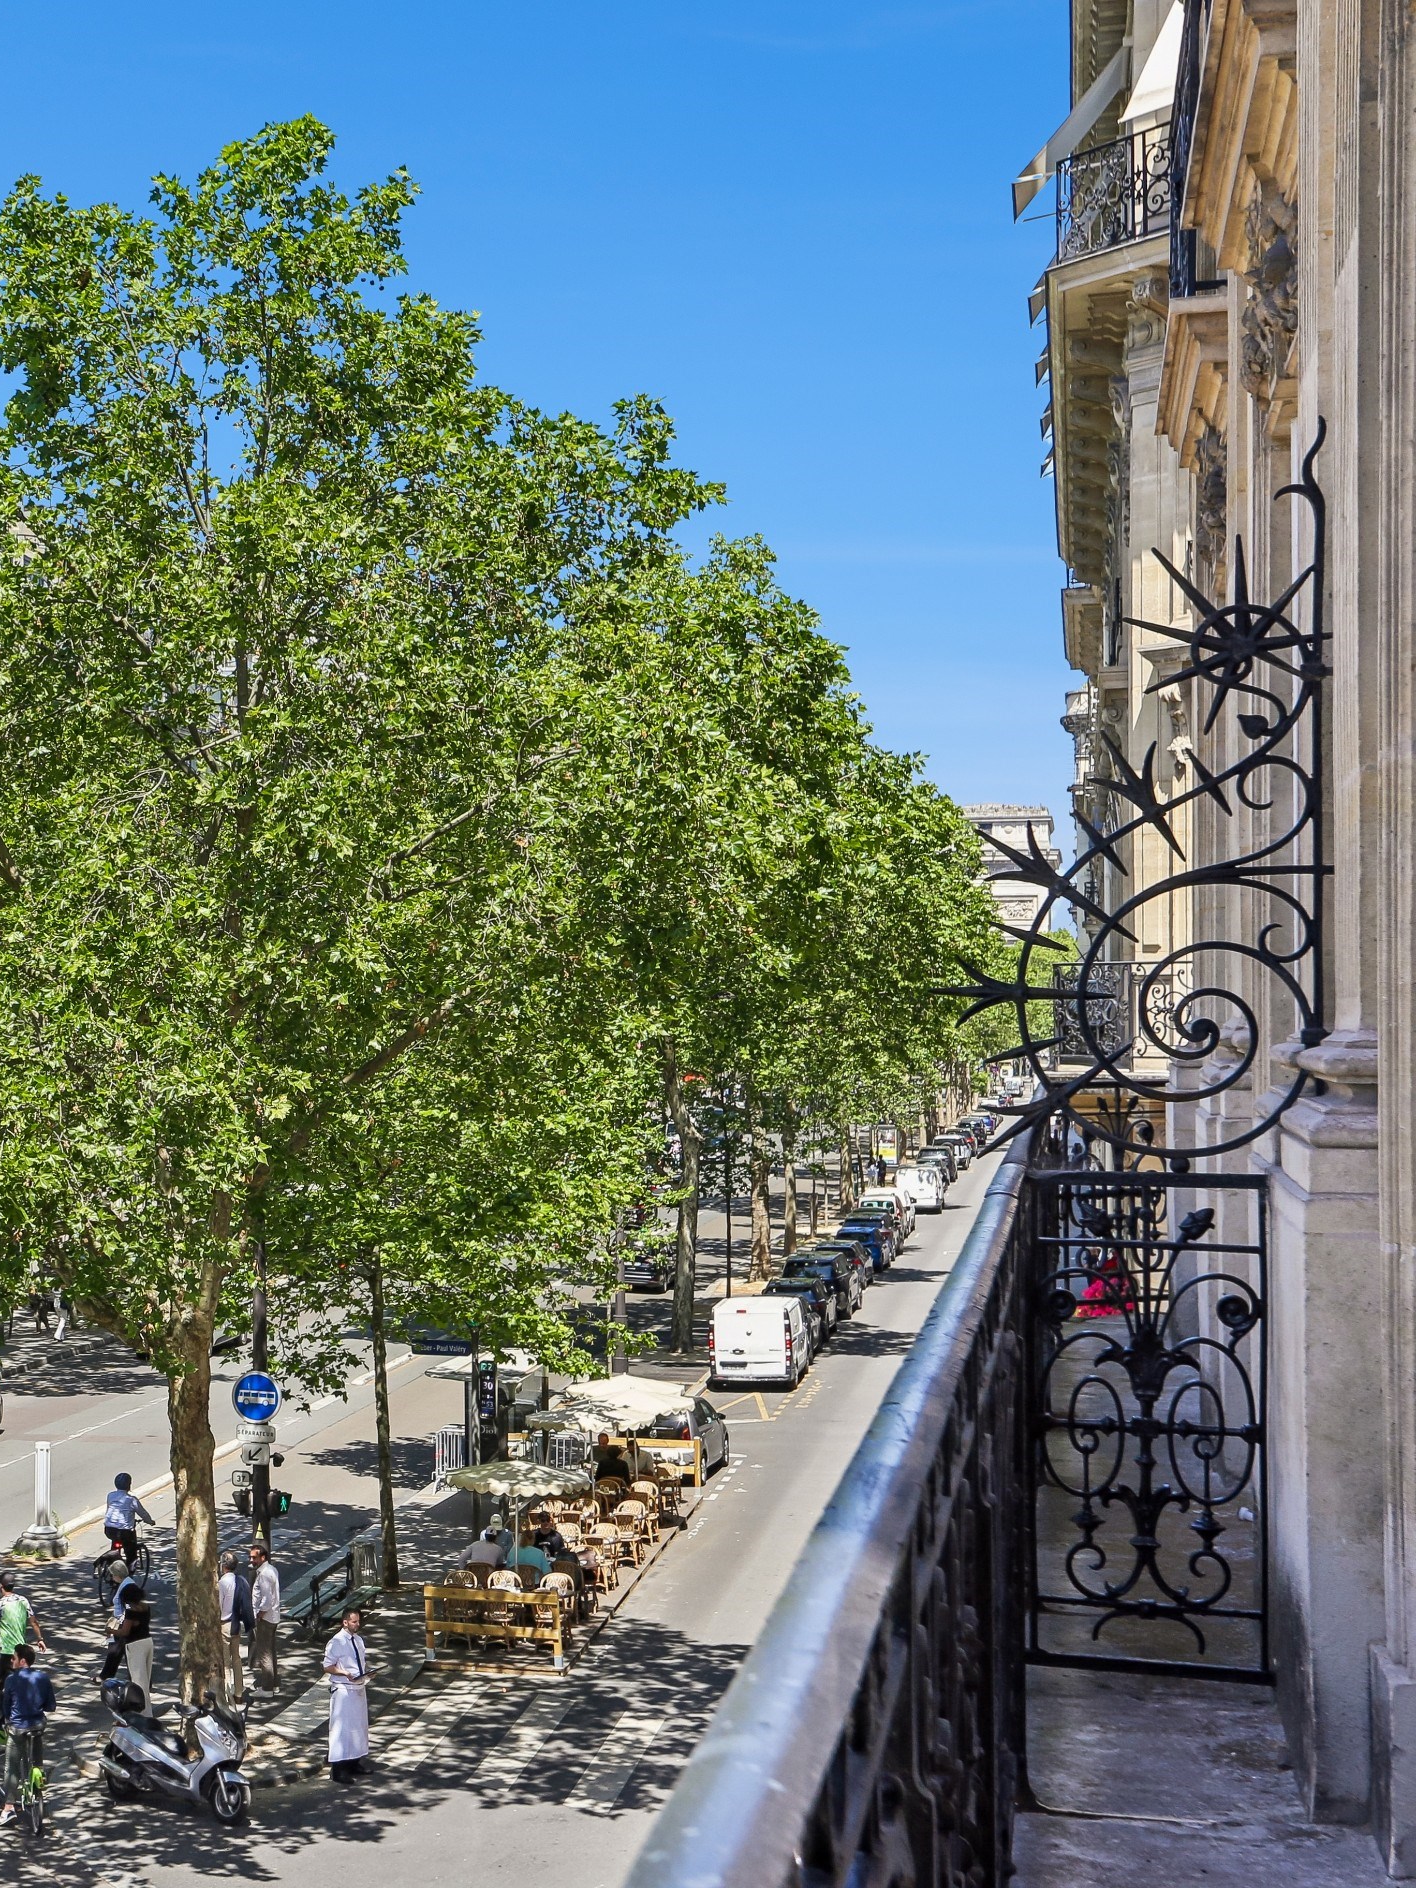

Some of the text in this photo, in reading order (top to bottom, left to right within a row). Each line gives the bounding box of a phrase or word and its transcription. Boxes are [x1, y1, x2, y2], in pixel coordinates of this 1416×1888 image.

[436, 1344, 448, 1352] Paul
[449, 1345, 467, 1354] Valéry
[482, 1381, 494, 1391] 30
